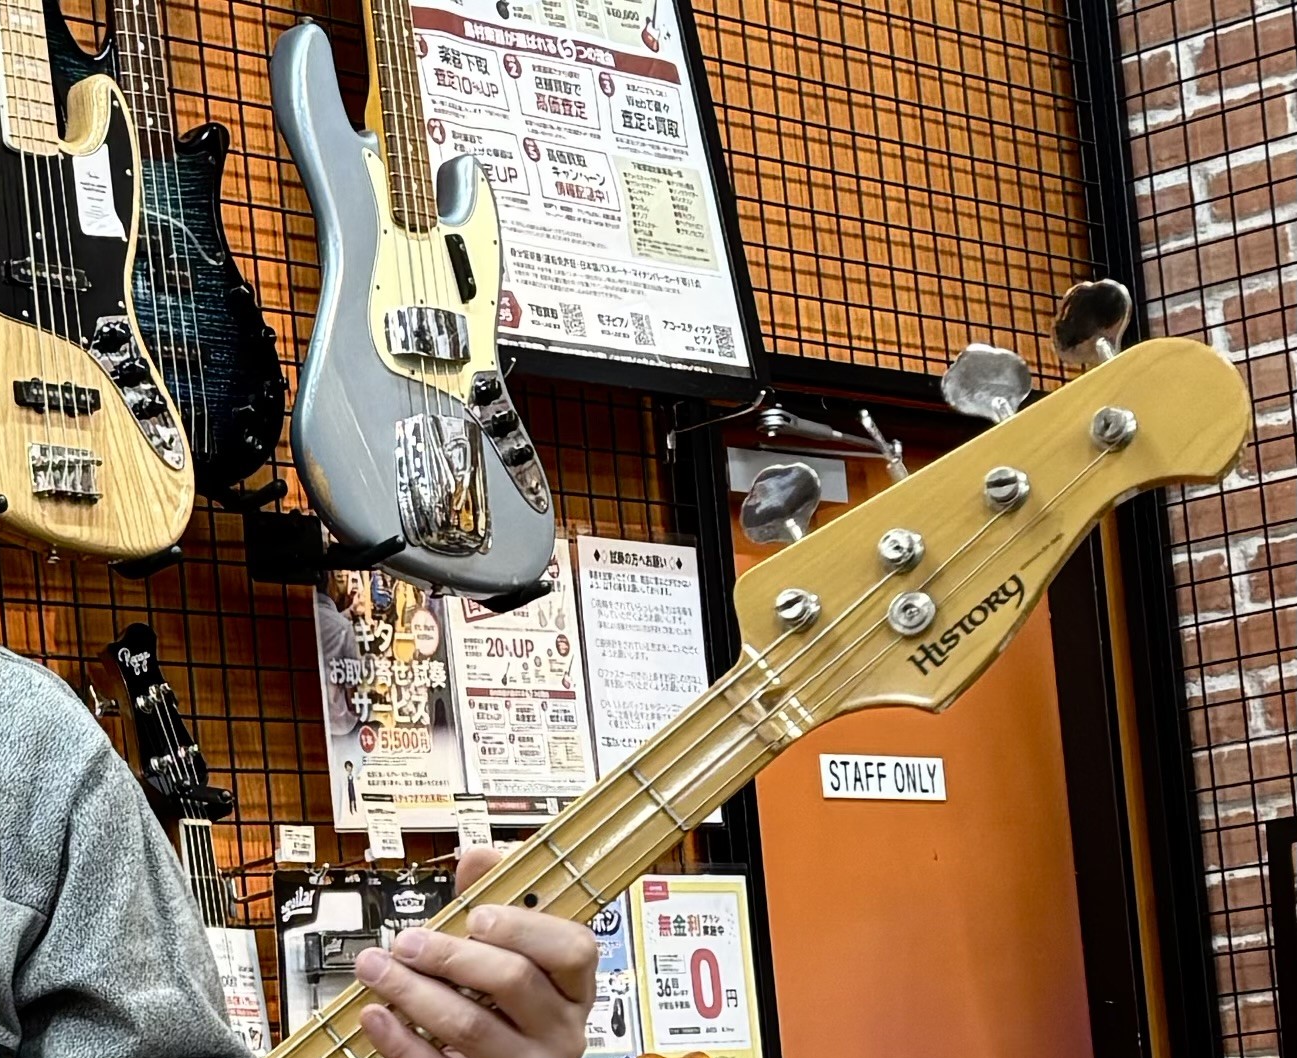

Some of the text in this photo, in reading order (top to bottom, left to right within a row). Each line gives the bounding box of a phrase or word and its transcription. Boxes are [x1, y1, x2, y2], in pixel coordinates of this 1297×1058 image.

[328, 657, 447, 688] お取り寄せ試奏
[351, 686, 430, 725] サービス
[829, 759, 937, 794] STAFF ONLY
[658, 914, 701, 937] 無金利
[690, 947, 739, 1019] 0 円
